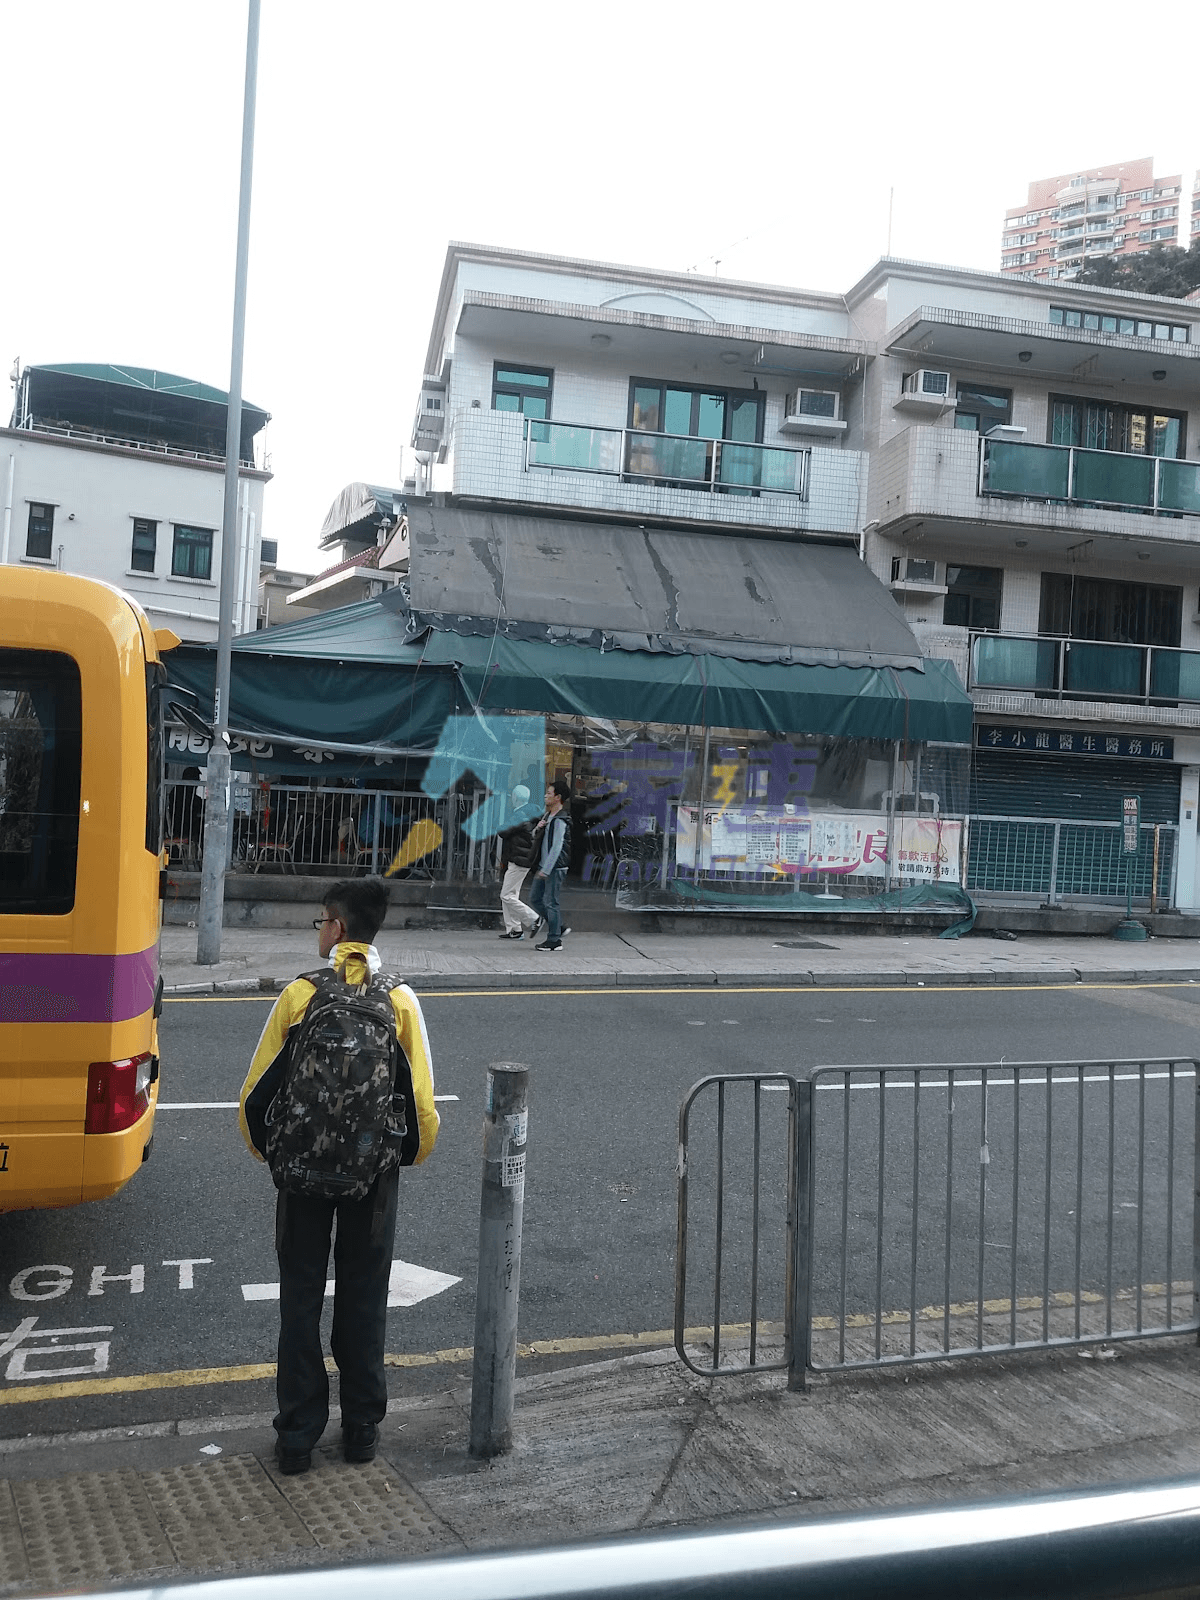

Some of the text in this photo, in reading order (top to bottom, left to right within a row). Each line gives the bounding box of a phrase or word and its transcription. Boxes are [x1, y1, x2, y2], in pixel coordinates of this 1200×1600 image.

[988, 729, 1165, 757] 李小龍醫生醫務所
[0, 1316, 114, 1380] 右
